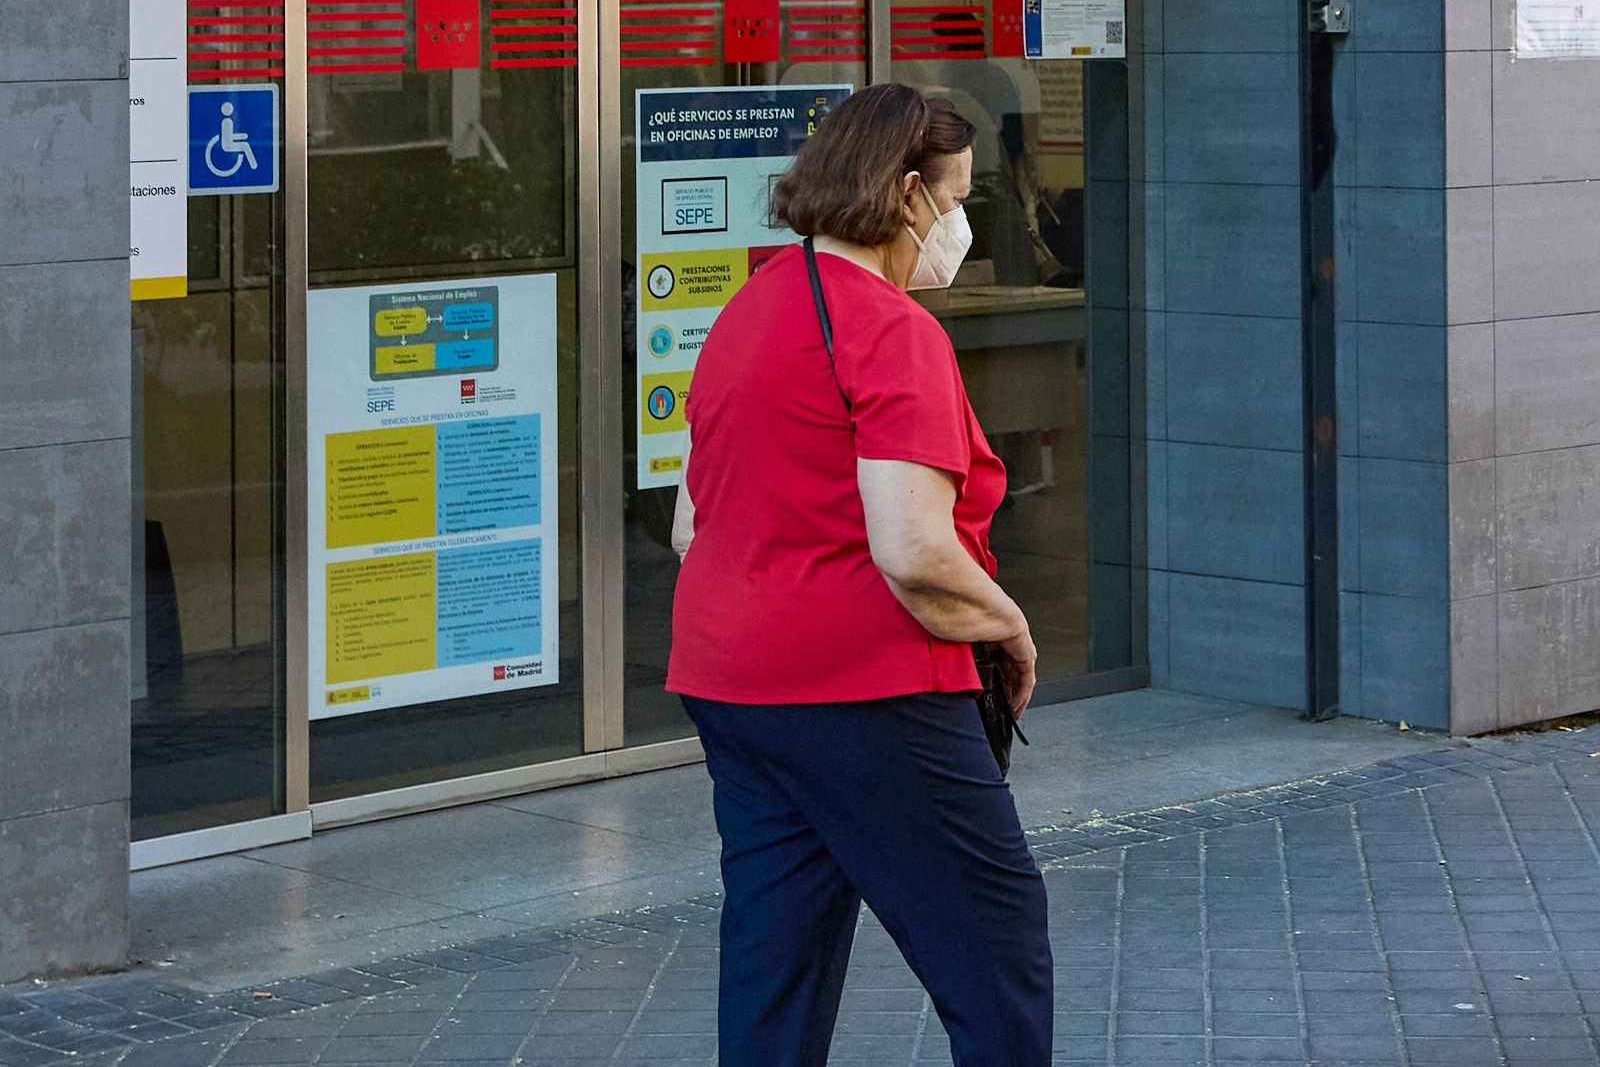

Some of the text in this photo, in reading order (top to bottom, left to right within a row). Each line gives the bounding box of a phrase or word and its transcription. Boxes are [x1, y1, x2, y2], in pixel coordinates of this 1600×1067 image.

[648, 108, 795, 126] ¿QUÉ SERVICIOS SE PRESTAN
[650, 127, 779, 142] EN OFICINAS DE EMPLEO?
[675, 207, 714, 226] SEPE
[682, 265, 731, 275] PRESTACIONES
[679, 275, 731, 285] CONTRIBUTIVAS
[688, 285, 723, 294] SUBSIDIOS
[391, 295, 416, 303] Sistema
[417, 293, 445, 302] Nacional
[455, 291, 477, 300] Empleo
[366, 399, 395, 413] SEPE
[381, 418, 409, 426] SERVICIOS
[410, 416, 422, 424] QUE
[430, 412, 455, 422] PRESTAN
[507, 660, 543, 671] Comunidad
[518, 668, 543, 677] Madrid
